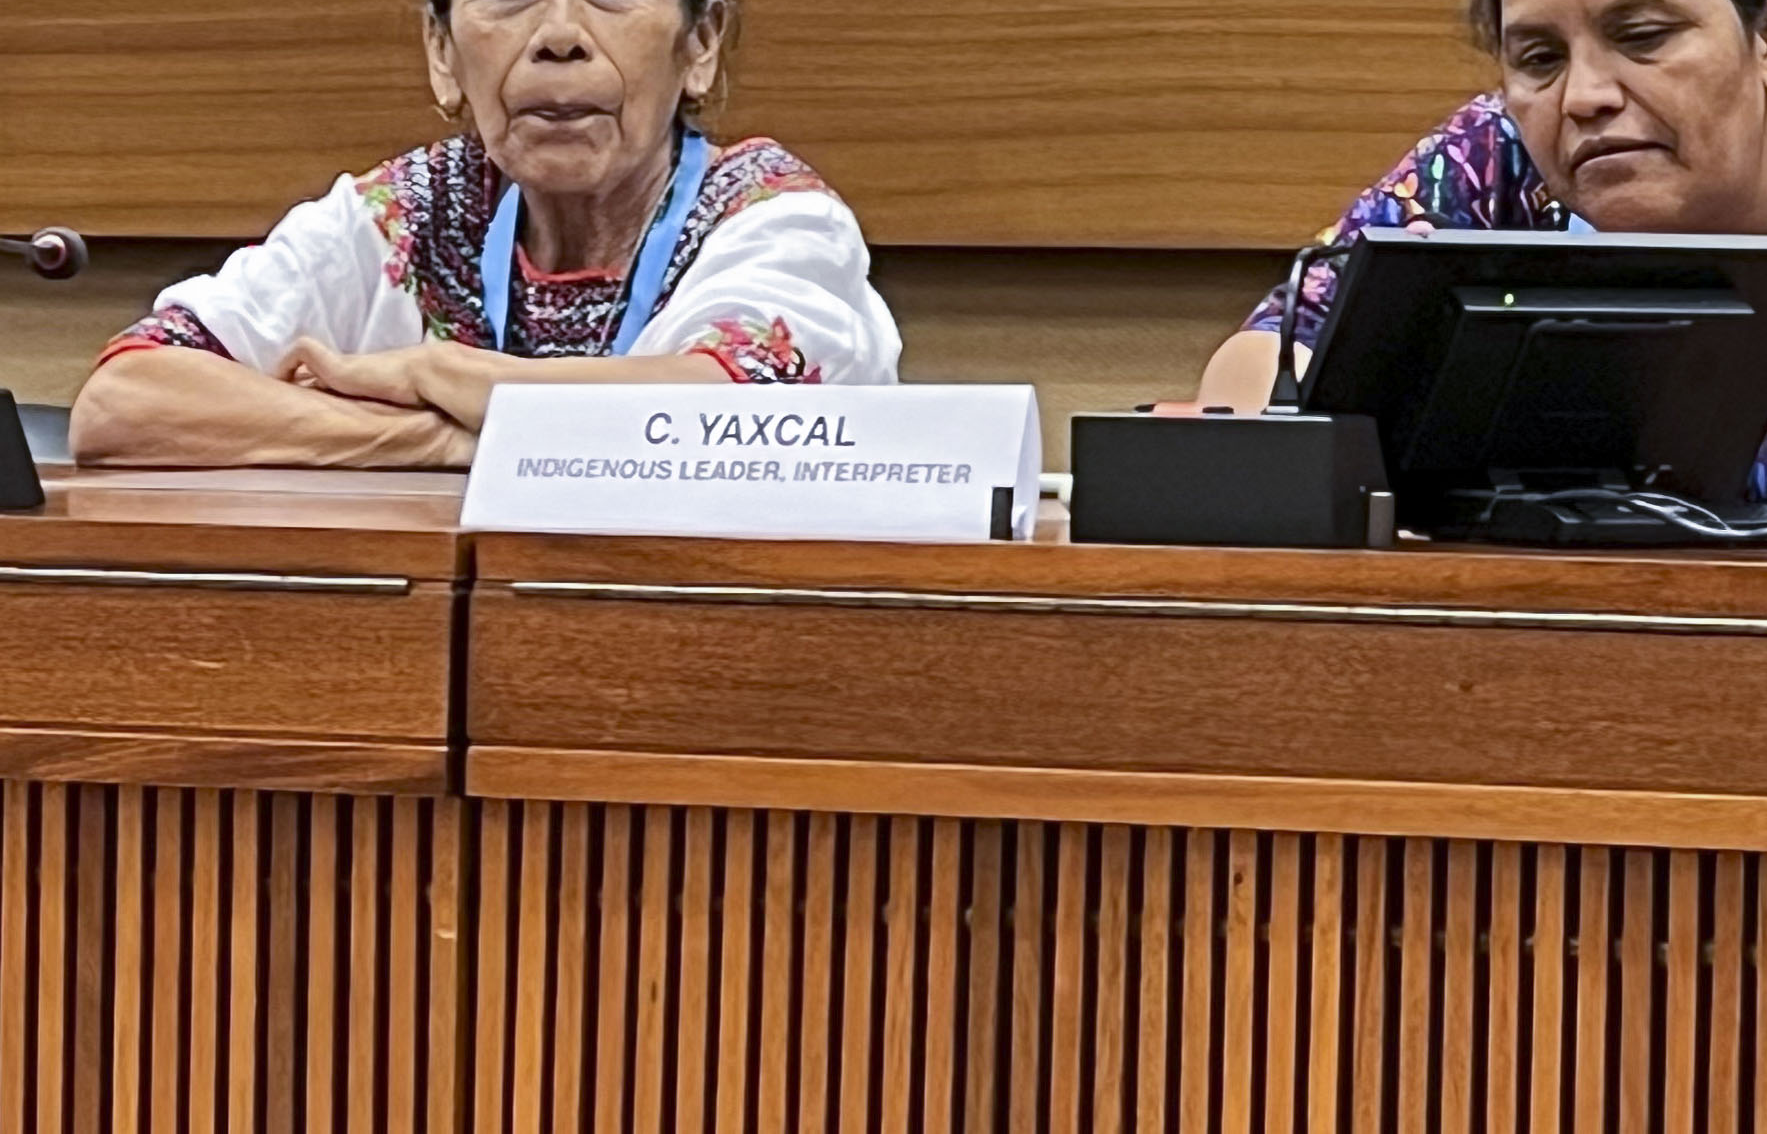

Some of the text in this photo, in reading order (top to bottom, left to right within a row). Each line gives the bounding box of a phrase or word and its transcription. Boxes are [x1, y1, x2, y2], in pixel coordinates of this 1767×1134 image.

[644, 411, 857, 447] C. YAXCAL
[517, 458, 972, 484] INDIGENOUS LEADER, INTERPRETER
